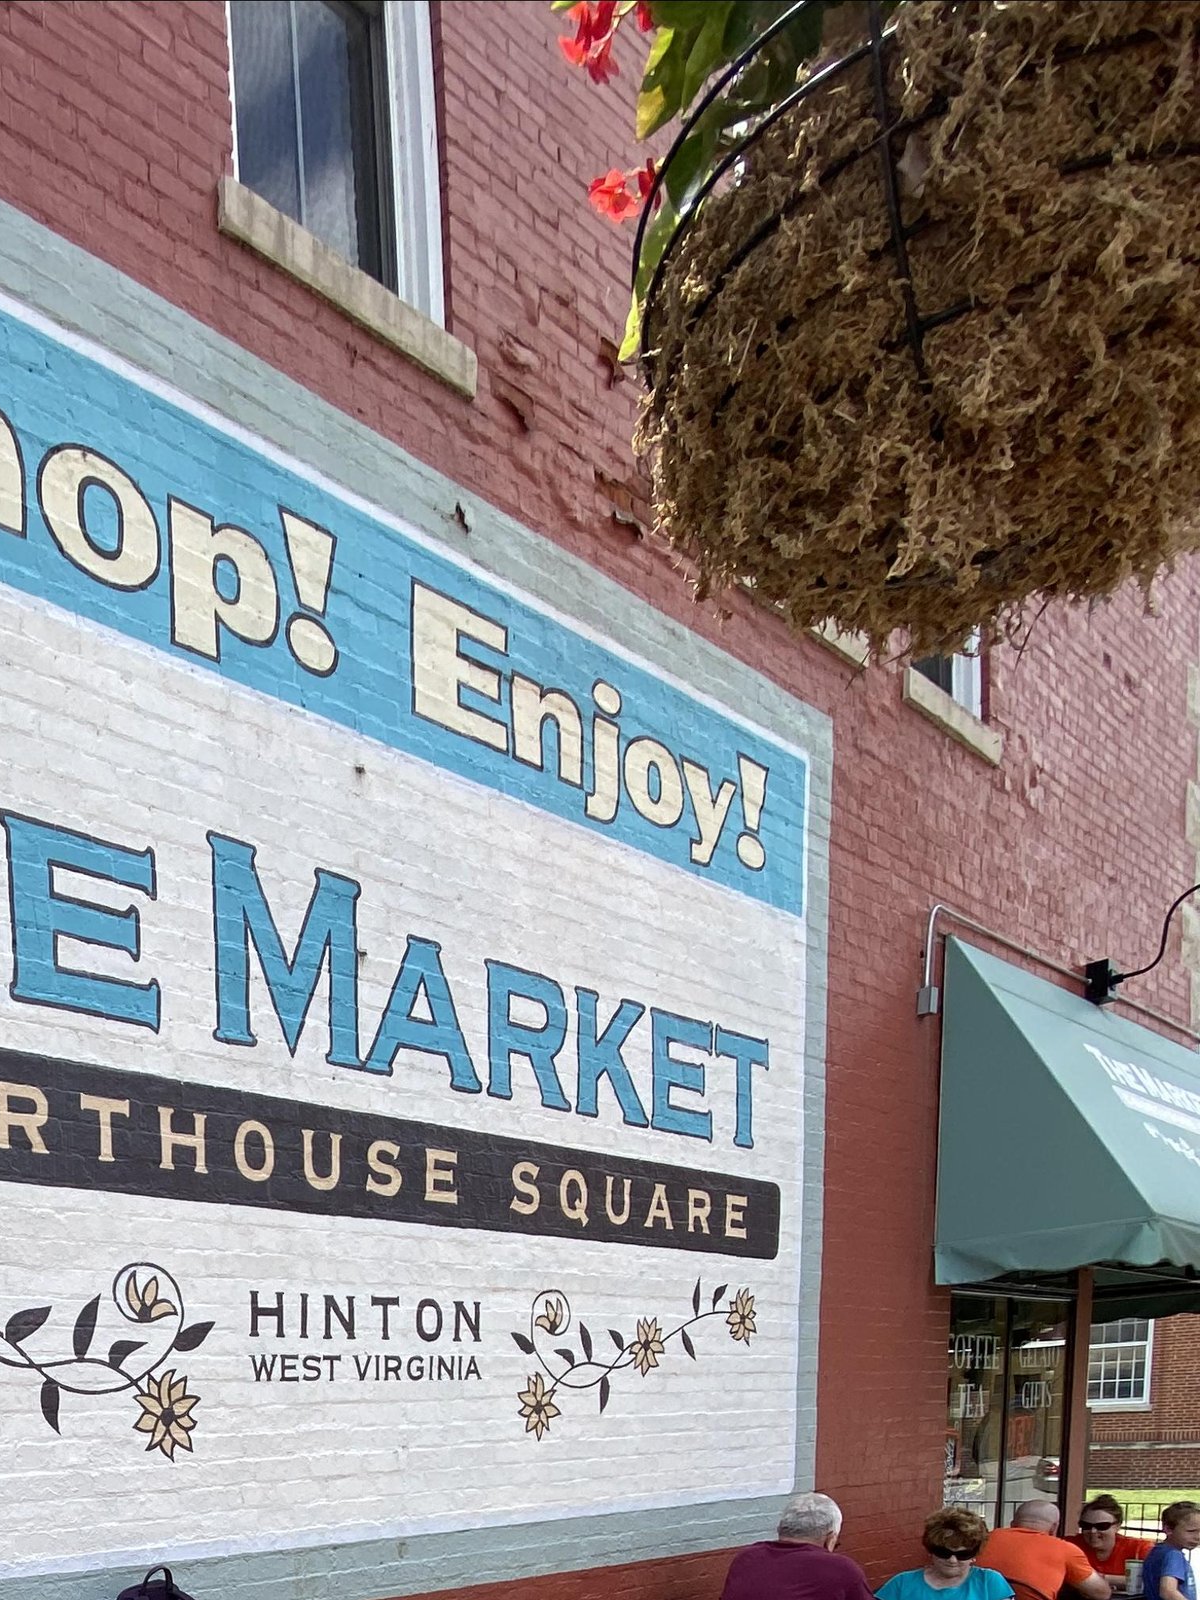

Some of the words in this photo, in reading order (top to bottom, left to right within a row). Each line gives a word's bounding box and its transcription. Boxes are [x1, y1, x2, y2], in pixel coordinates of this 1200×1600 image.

[411, 576, 769, 871] Enjoy!
[206, 830, 770, 1148] MARKET
[509, 1161, 749, 1241] SQUARE
[249, 1290, 483, 1342] HINTON
[252, 1354, 343, 1382] WEST
[352, 1354, 483, 1381] VIRGINIA
[948, 1333, 1000, 1370] COFFEE
[957, 1383, 985, 1418] TEA
[1022, 1381, 1052, 1408] GIFTS
